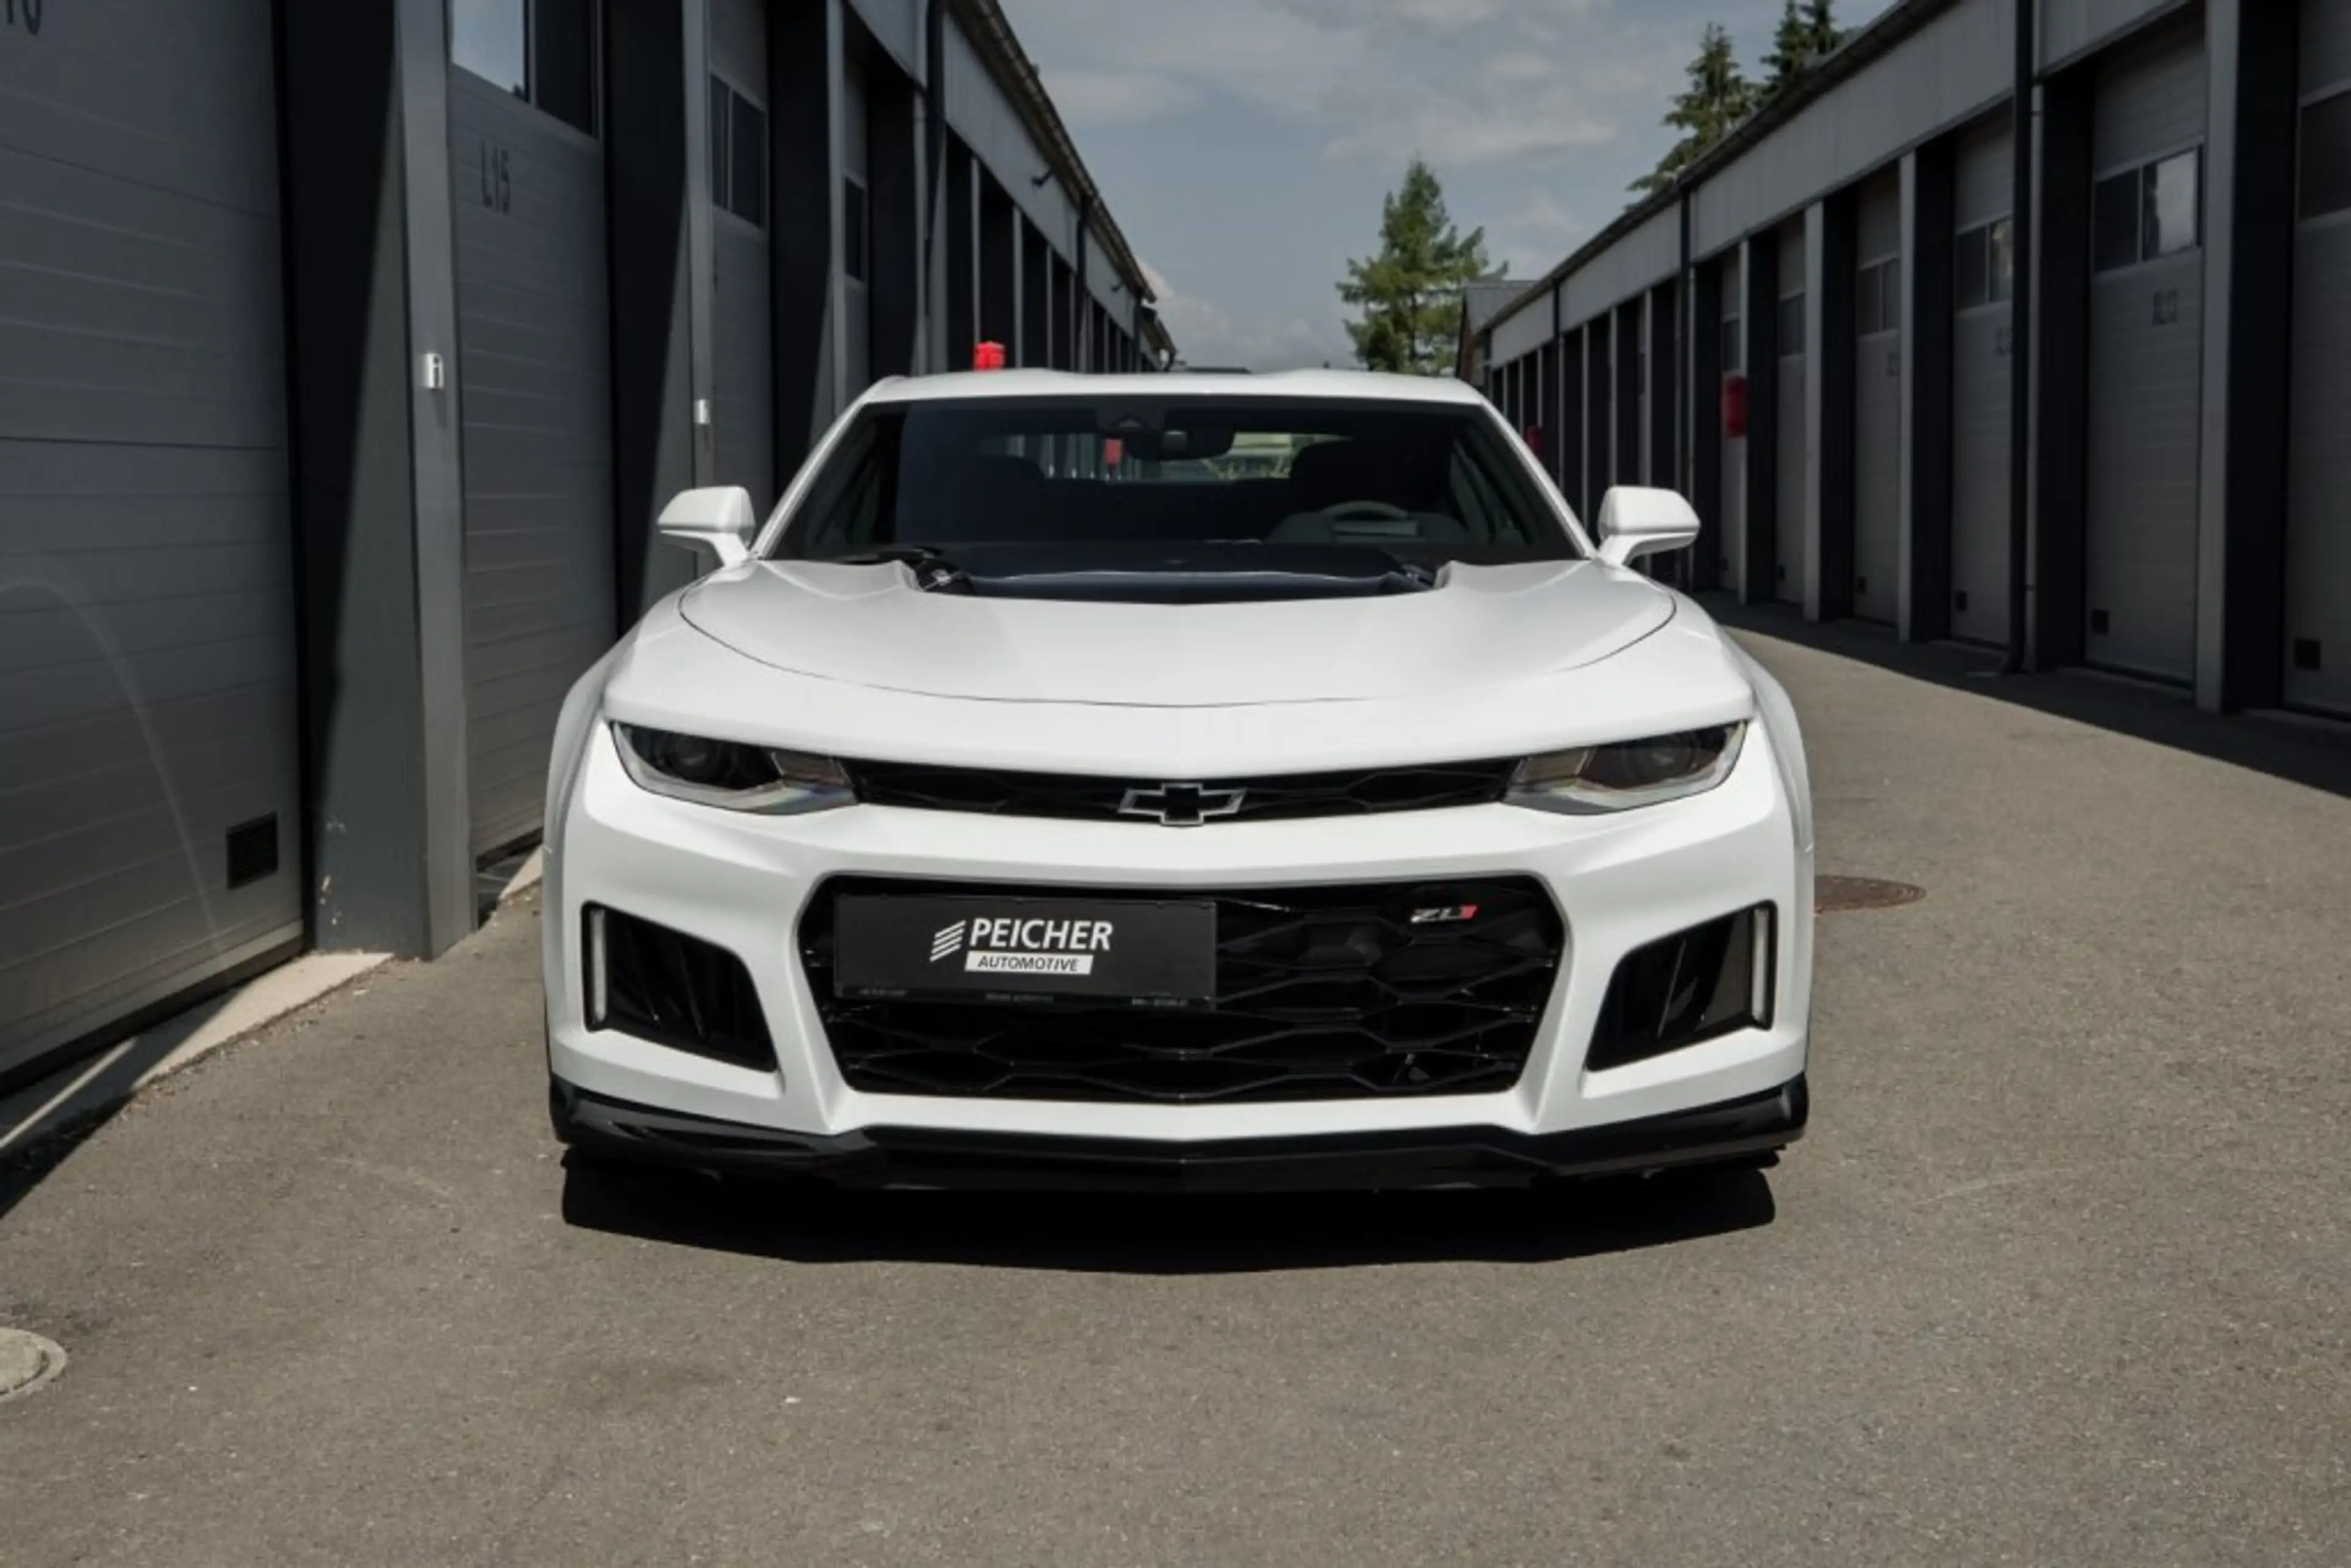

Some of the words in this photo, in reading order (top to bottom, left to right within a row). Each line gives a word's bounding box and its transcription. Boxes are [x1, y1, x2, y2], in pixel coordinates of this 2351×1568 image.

[480, 140, 511, 214] L15
[969, 918, 1114, 951] PEICHER
[978, 955, 1079, 972] AUTOMOTIVE
